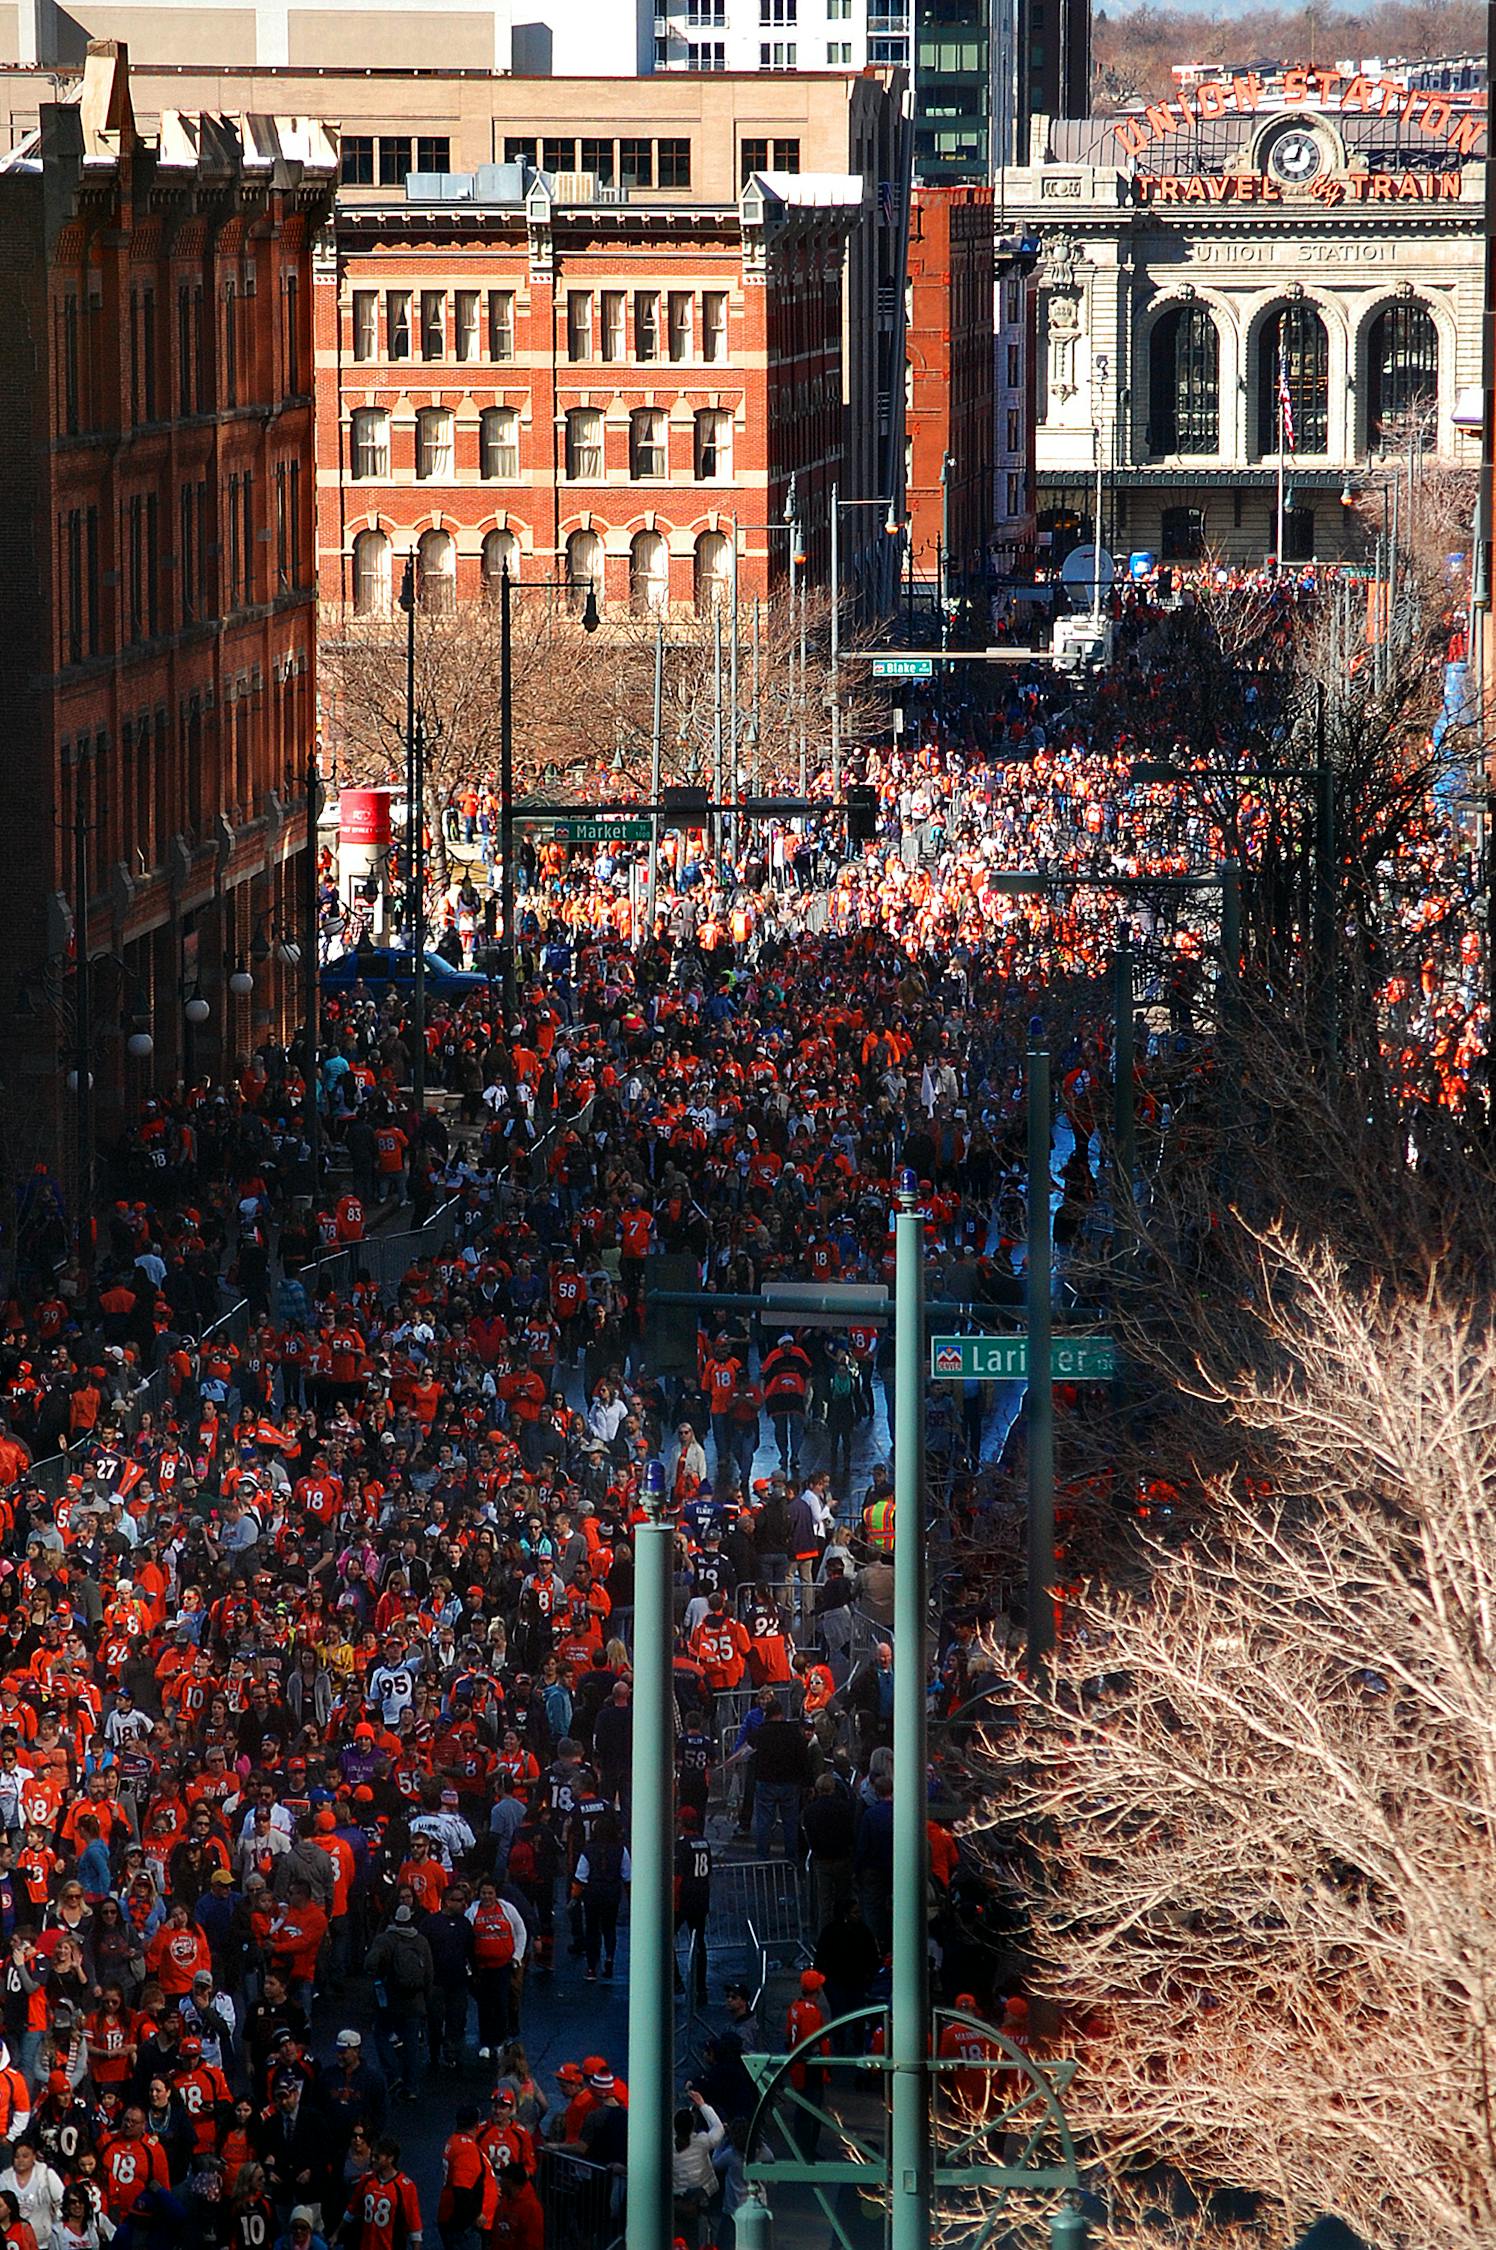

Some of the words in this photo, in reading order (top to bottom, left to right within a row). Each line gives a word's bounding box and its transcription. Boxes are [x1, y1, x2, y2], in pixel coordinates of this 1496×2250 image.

[1114, 75, 1263, 156] UNION
[1284, 70, 1489, 155] STATION
[1137, 175, 1281, 201] TRAVEL
[1309, 172, 1344, 206] by
[1351, 174, 1462, 198] TRAIN
[1197, 244, 1274, 262] UNION
[1297, 244, 1397, 262] STATION
[886, 662, 917, 673] Blake
[576, 824, 627, 839] Market
[656, 1126, 672, 1139] 58
[152, 1153, 167, 1167] 18
[347, 1207, 361, 1221] 83
[630, 1221, 639, 1236] 7
[815, 1251, 828, 1267] 18
[558, 1283, 577, 1298] 58
[43, 1311, 58, 1324] 99
[286, 1341, 298, 1354] 18
[530, 1331, 549, 1351] 27
[852, 1332, 866, 1348] 18
[972, 1343, 1087, 1372] Larier
[714, 1371, 731, 1388] 18
[97, 1460, 118, 1480] 27
[160, 1461, 175, 1479] 18
[306, 1490, 324, 1510] 18
[697, 1516, 711, 1540] 7
[755, 1617, 779, 1637] 92
[381, 1675, 407, 1699] 95
[186, 1686, 204, 1710] 10
[116, 1726, 134, 1746] 18
[684, 1750, 707, 1770] 58
[551, 1784, 575, 1812] 18
[693, 1852, 709, 1878] 18
[105, 2033, 123, 2050] 18
[179, 2085, 203, 2113] 18
[112, 2152, 136, 2185] 18
[364, 2193, 390, 2227] 88
[240, 2214, 265, 2246] 10
